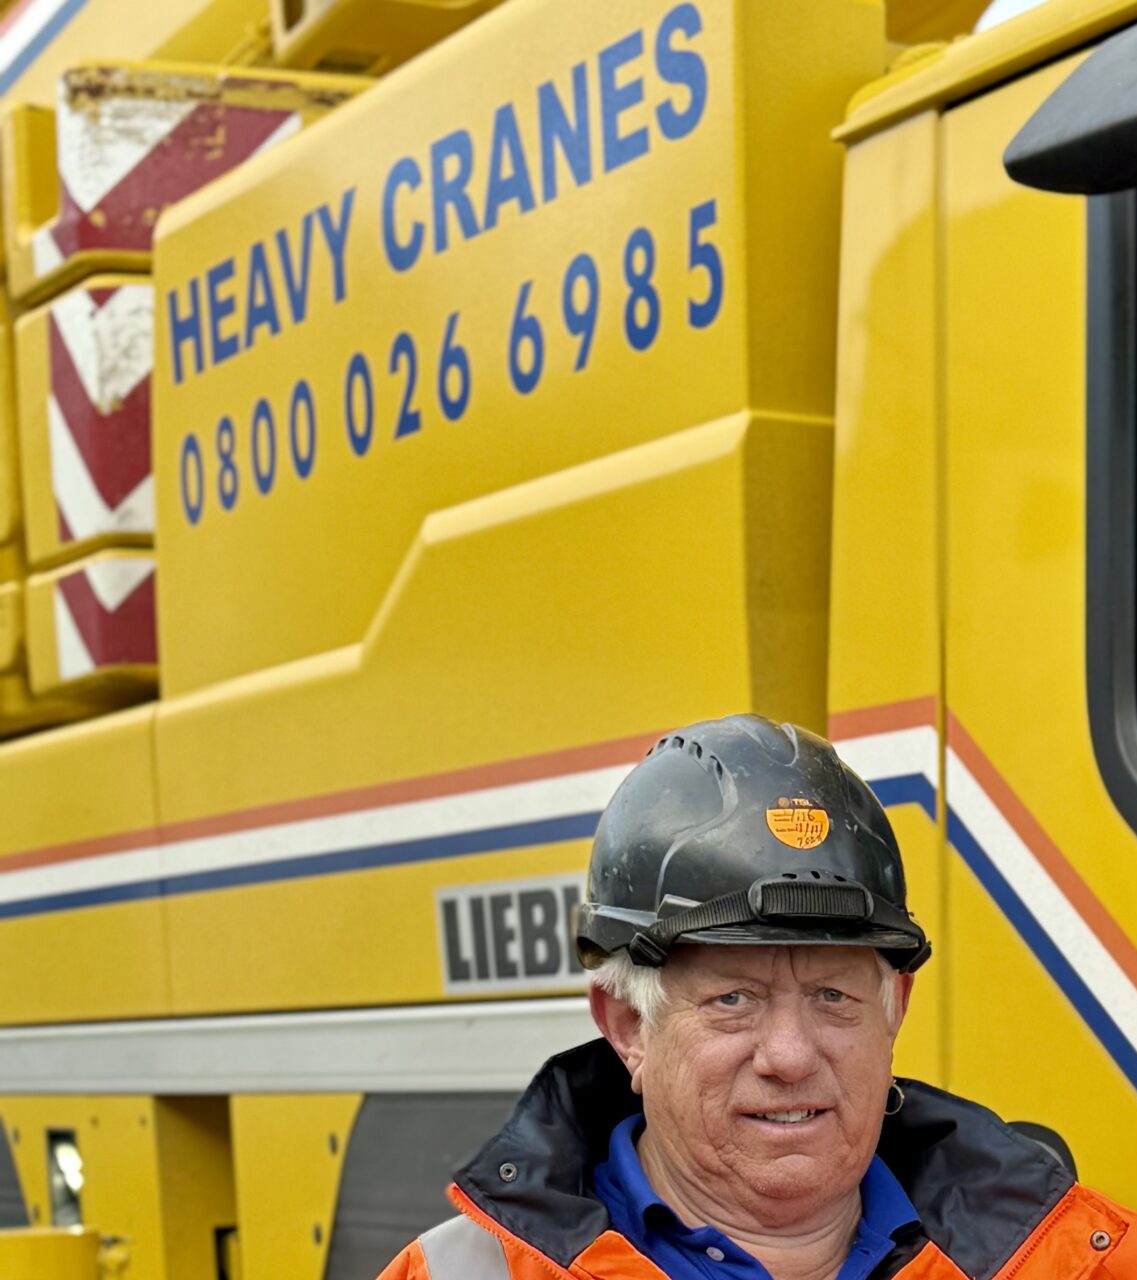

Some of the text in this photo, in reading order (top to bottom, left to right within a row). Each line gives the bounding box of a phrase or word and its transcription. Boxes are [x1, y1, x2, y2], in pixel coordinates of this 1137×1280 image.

[167, 2, 709, 385] HEAVY CRANES
[180, 199, 724, 525] 0800 026 6985
